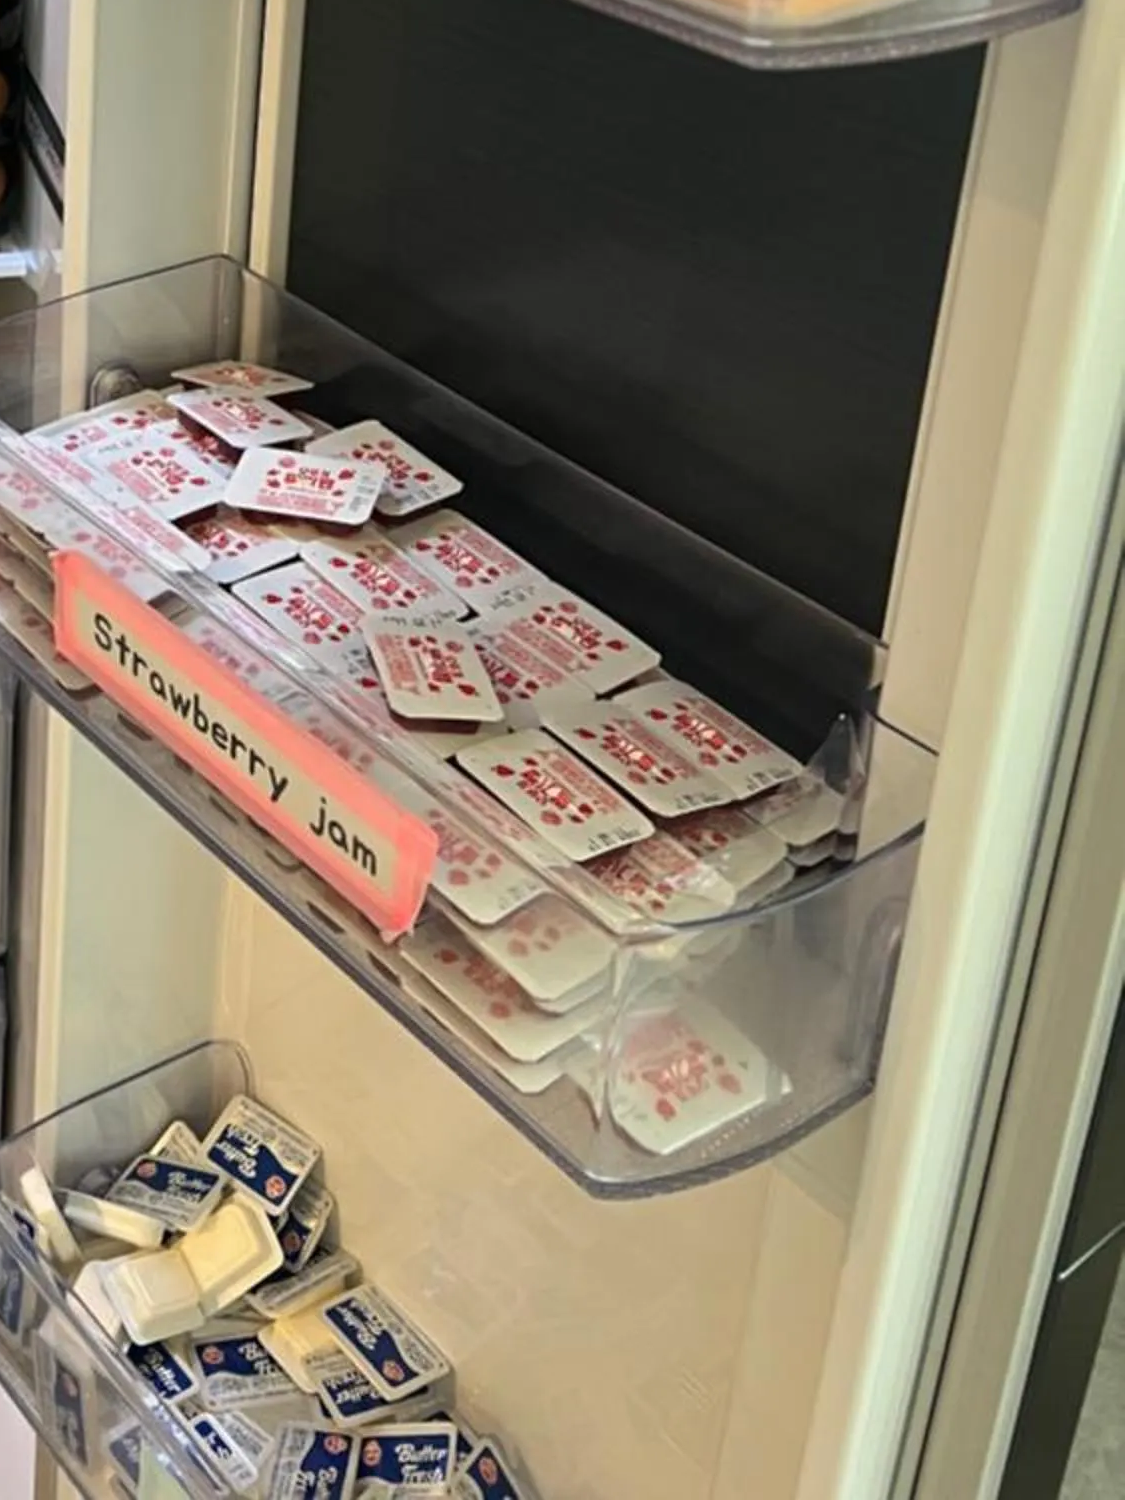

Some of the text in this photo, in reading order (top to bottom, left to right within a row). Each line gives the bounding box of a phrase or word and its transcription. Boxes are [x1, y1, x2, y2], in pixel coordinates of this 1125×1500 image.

[92, 612, 378, 877] Strawberry jam
[395, 1443, 446, 1463] Butter
